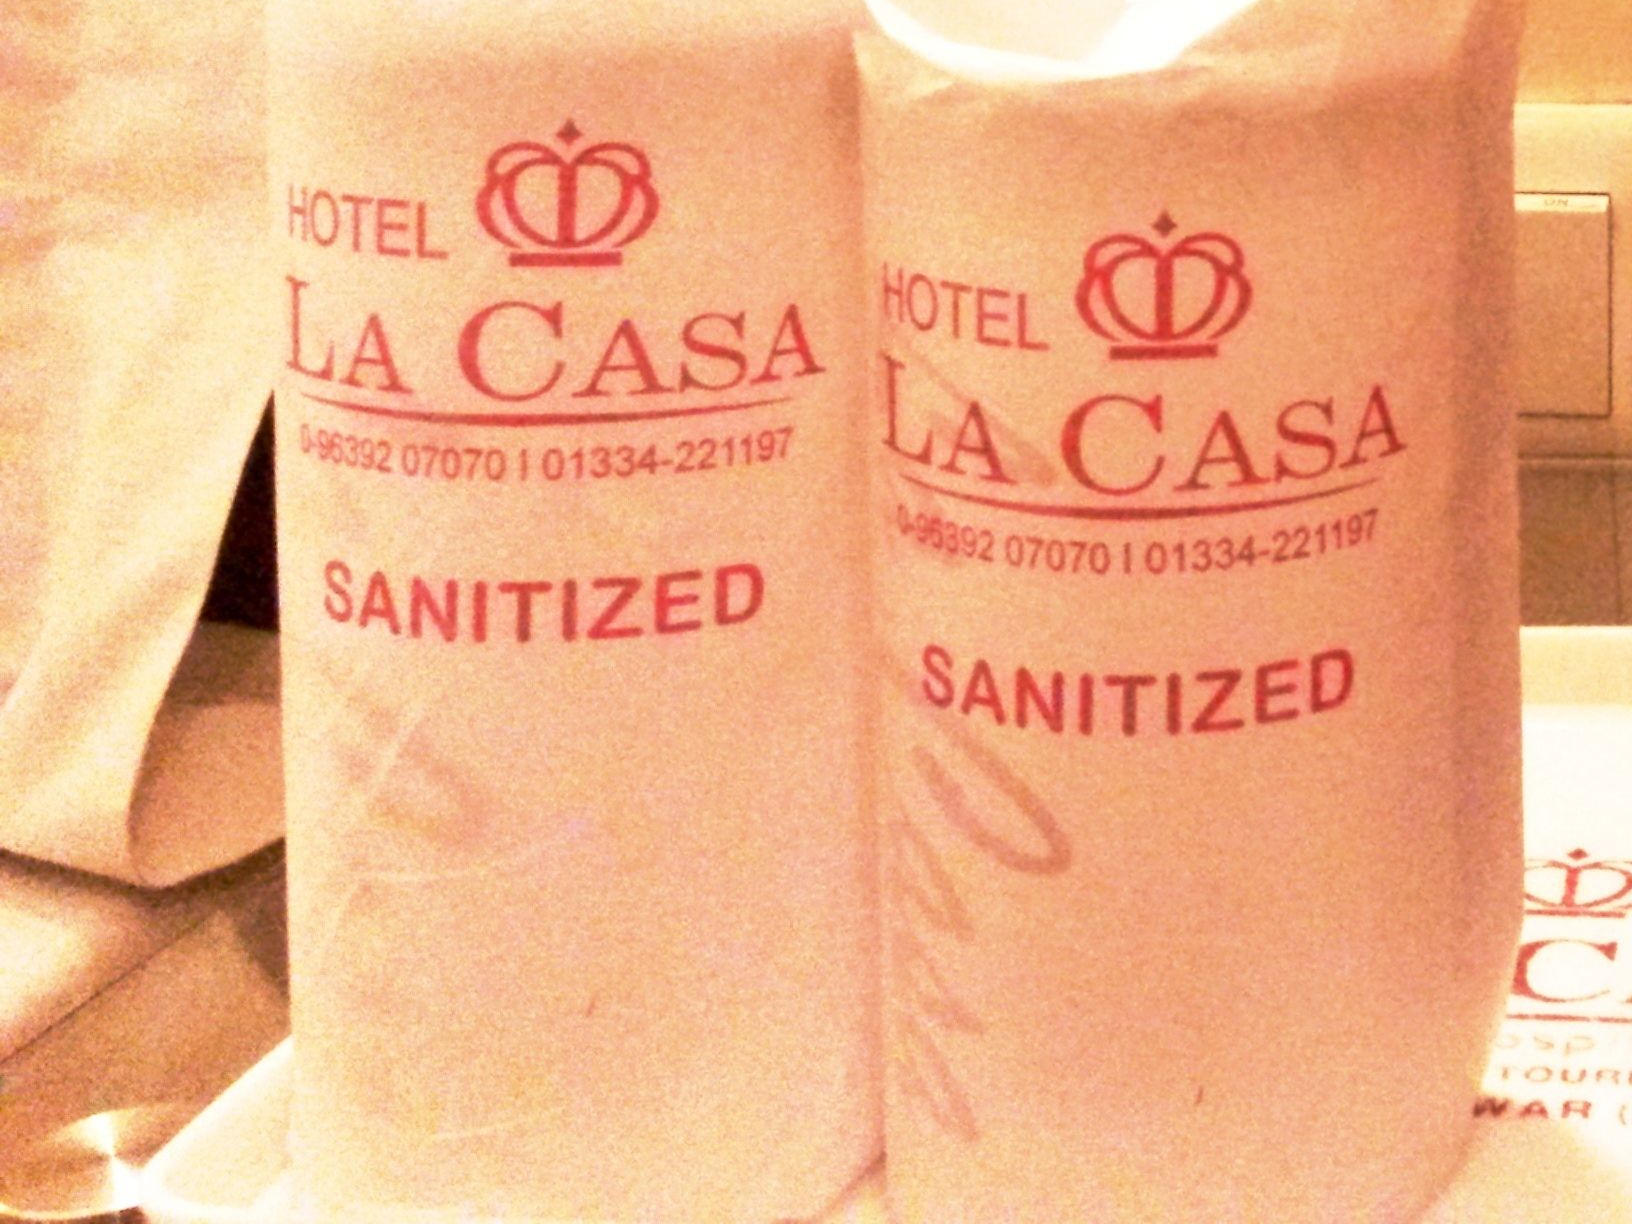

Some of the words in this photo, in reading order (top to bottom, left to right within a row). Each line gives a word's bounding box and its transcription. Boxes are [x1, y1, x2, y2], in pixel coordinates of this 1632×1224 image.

[288, 185, 448, 260] HOTEL
[286, 275, 413, 394] LA
[457, 301, 827, 403] CASA
[882, 262, 1050, 353] HOTEL
[401, 443, 507, 481] 07070
[542, 426, 796, 482] 01334-221197
[878, 349, 1018, 486] LA
[1060, 384, 1408, 497] CASA
[1006, 536, 1111, 574] 07070
[1144, 508, 1380, 574] 01334-221197
[323, 559, 765, 643] SANITIZED
[921, 643, 1356, 738] SANITIZED
